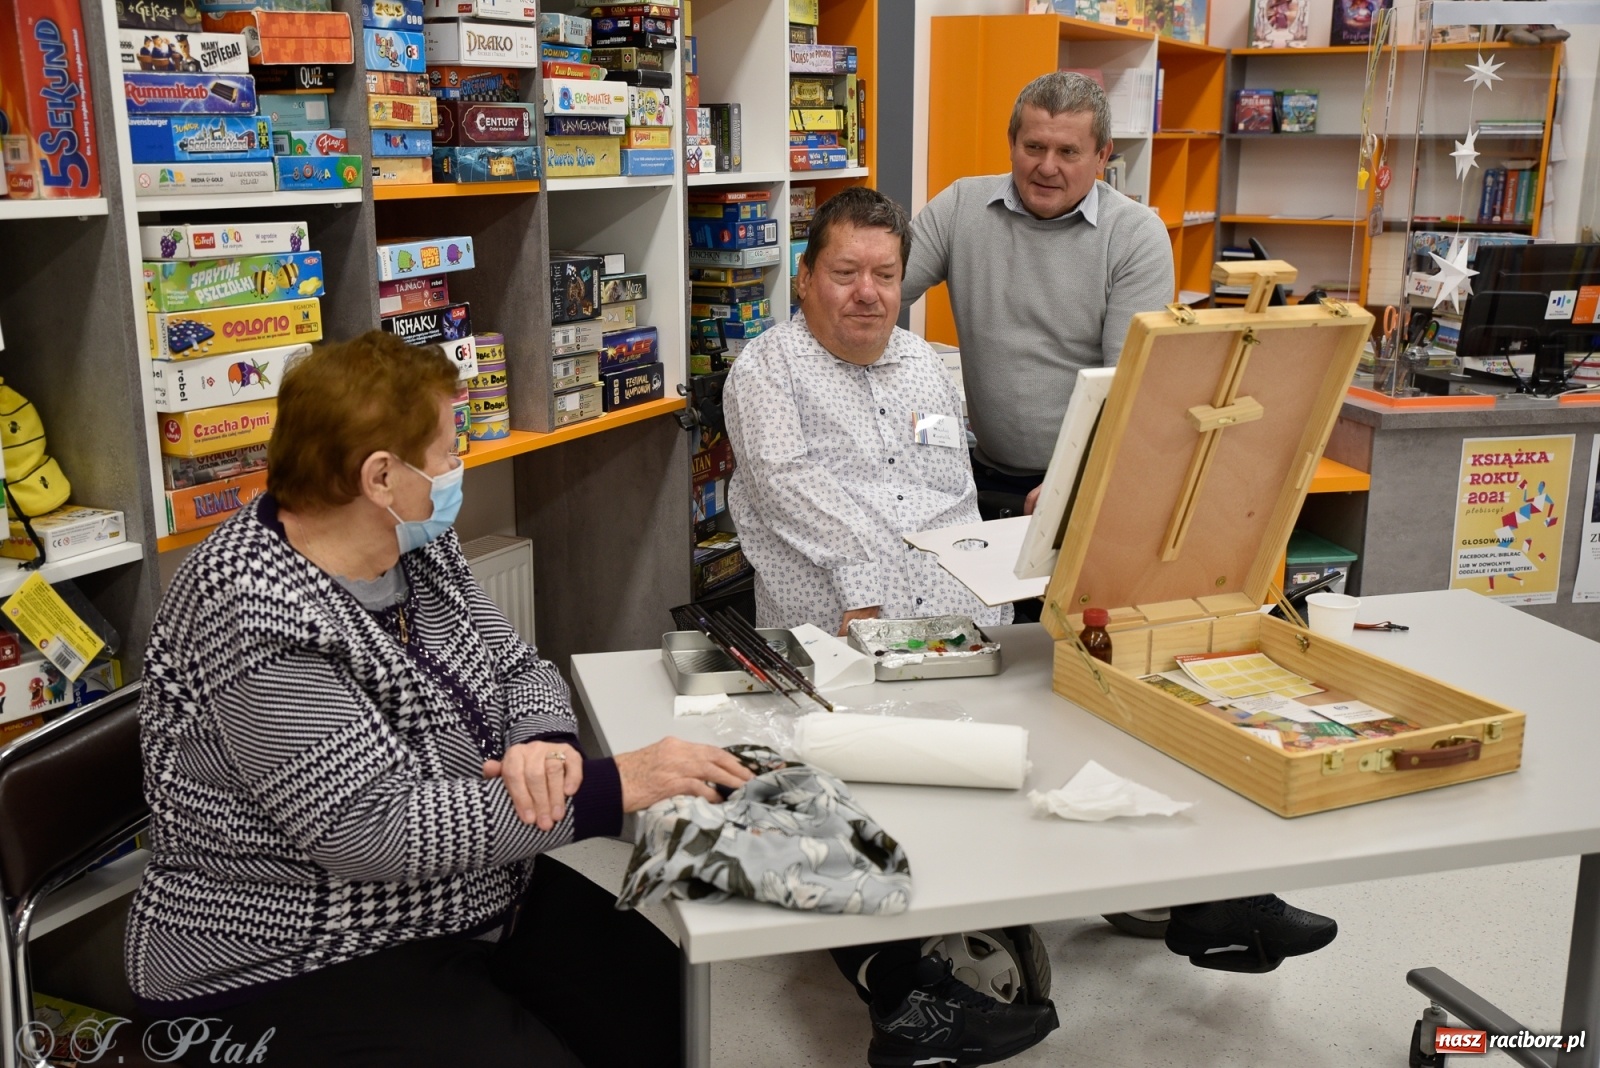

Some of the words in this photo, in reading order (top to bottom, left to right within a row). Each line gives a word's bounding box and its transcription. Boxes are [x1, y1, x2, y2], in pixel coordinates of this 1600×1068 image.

[135, 1, 170, 23] GEJSZE
[200, 41, 219, 51] MAMY
[200, 42, 241, 67] SZPIEGA!
[543, 48, 569, 58] DOMINO
[34, 19, 80, 156] SEKUND
[300, 67, 323, 88] QUIZ
[125, 81, 209, 105] Rummikub
[575, 92, 612, 106] EKOBOHATER
[128, 118, 168, 128] avensburger
[173, 123, 199, 134] JUNIOR
[476, 111, 519, 133] CENTURY
[547, 146, 574, 168] Puerto
[576, 145, 595, 167] Rico
[40, 151, 90, 189] 5
[200, 235, 215, 246] Trefl
[190, 261, 241, 289] SPRYTNE
[553, 264, 564, 293] Potter
[195, 276, 255, 305] PSZCZÓŁKI
[293, 303, 316, 311] EGMONT
[554, 294, 563, 318] Harry
[177, 369, 188, 402] rebel
[194, 419, 239, 438] Czacha
[240, 412, 270, 429] Dymi
[196, 450, 238, 464] GRAND
[691, 454, 711, 474] ATAN
[1471, 448, 1549, 468] KSIĄŻKA
[1469, 471, 1520, 485] ROKU
[193, 486, 244, 519] REMIK
[1467, 491, 1505, 504] 2021
[1465, 506, 1504, 516] plebiscyt
[74, 687, 82, 708] ebel
